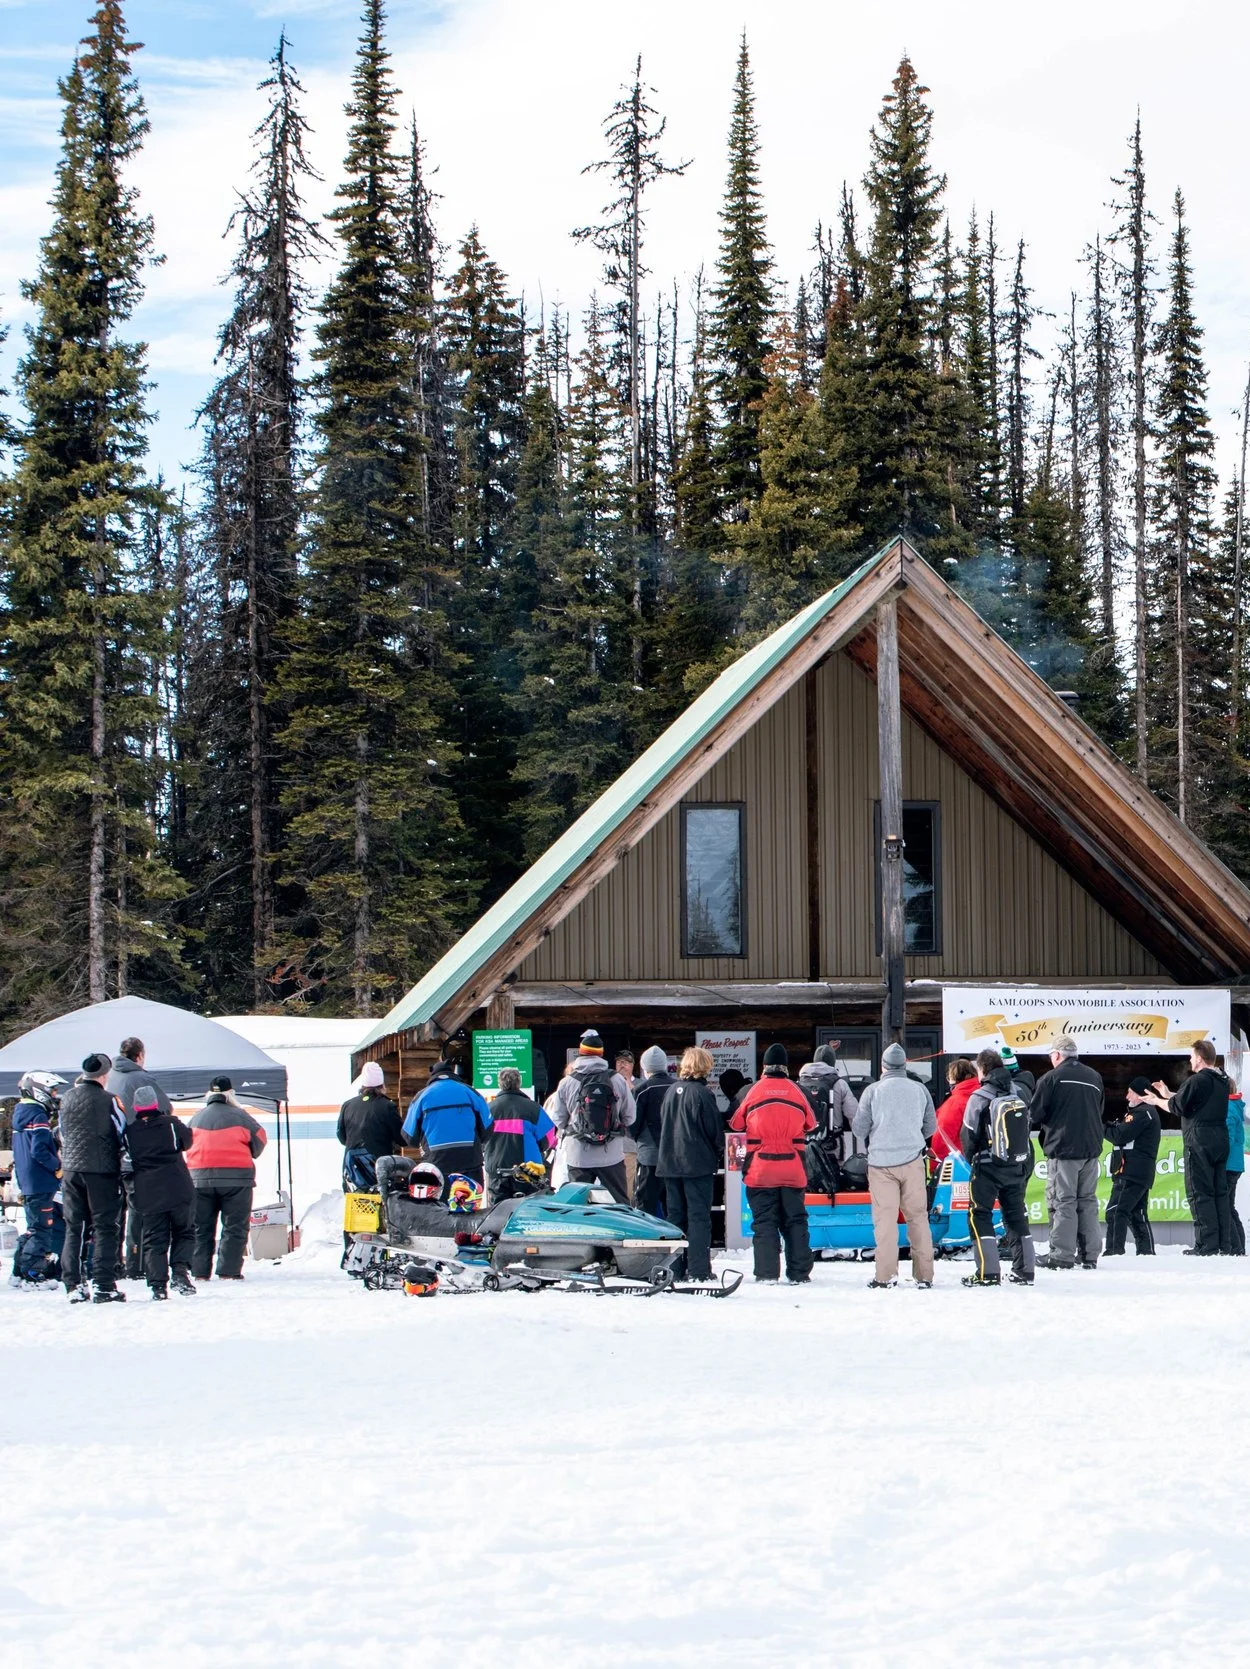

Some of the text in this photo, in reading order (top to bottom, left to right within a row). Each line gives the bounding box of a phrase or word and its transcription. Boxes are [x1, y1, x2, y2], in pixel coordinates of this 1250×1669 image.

[988, 998, 1185, 1008] KAMLOOPS SNOWMOBILE ASSOCIATION
[1015, 1020, 1155, 1043] 50th Anniversary
[701, 1036, 751, 1050] Please Respect
